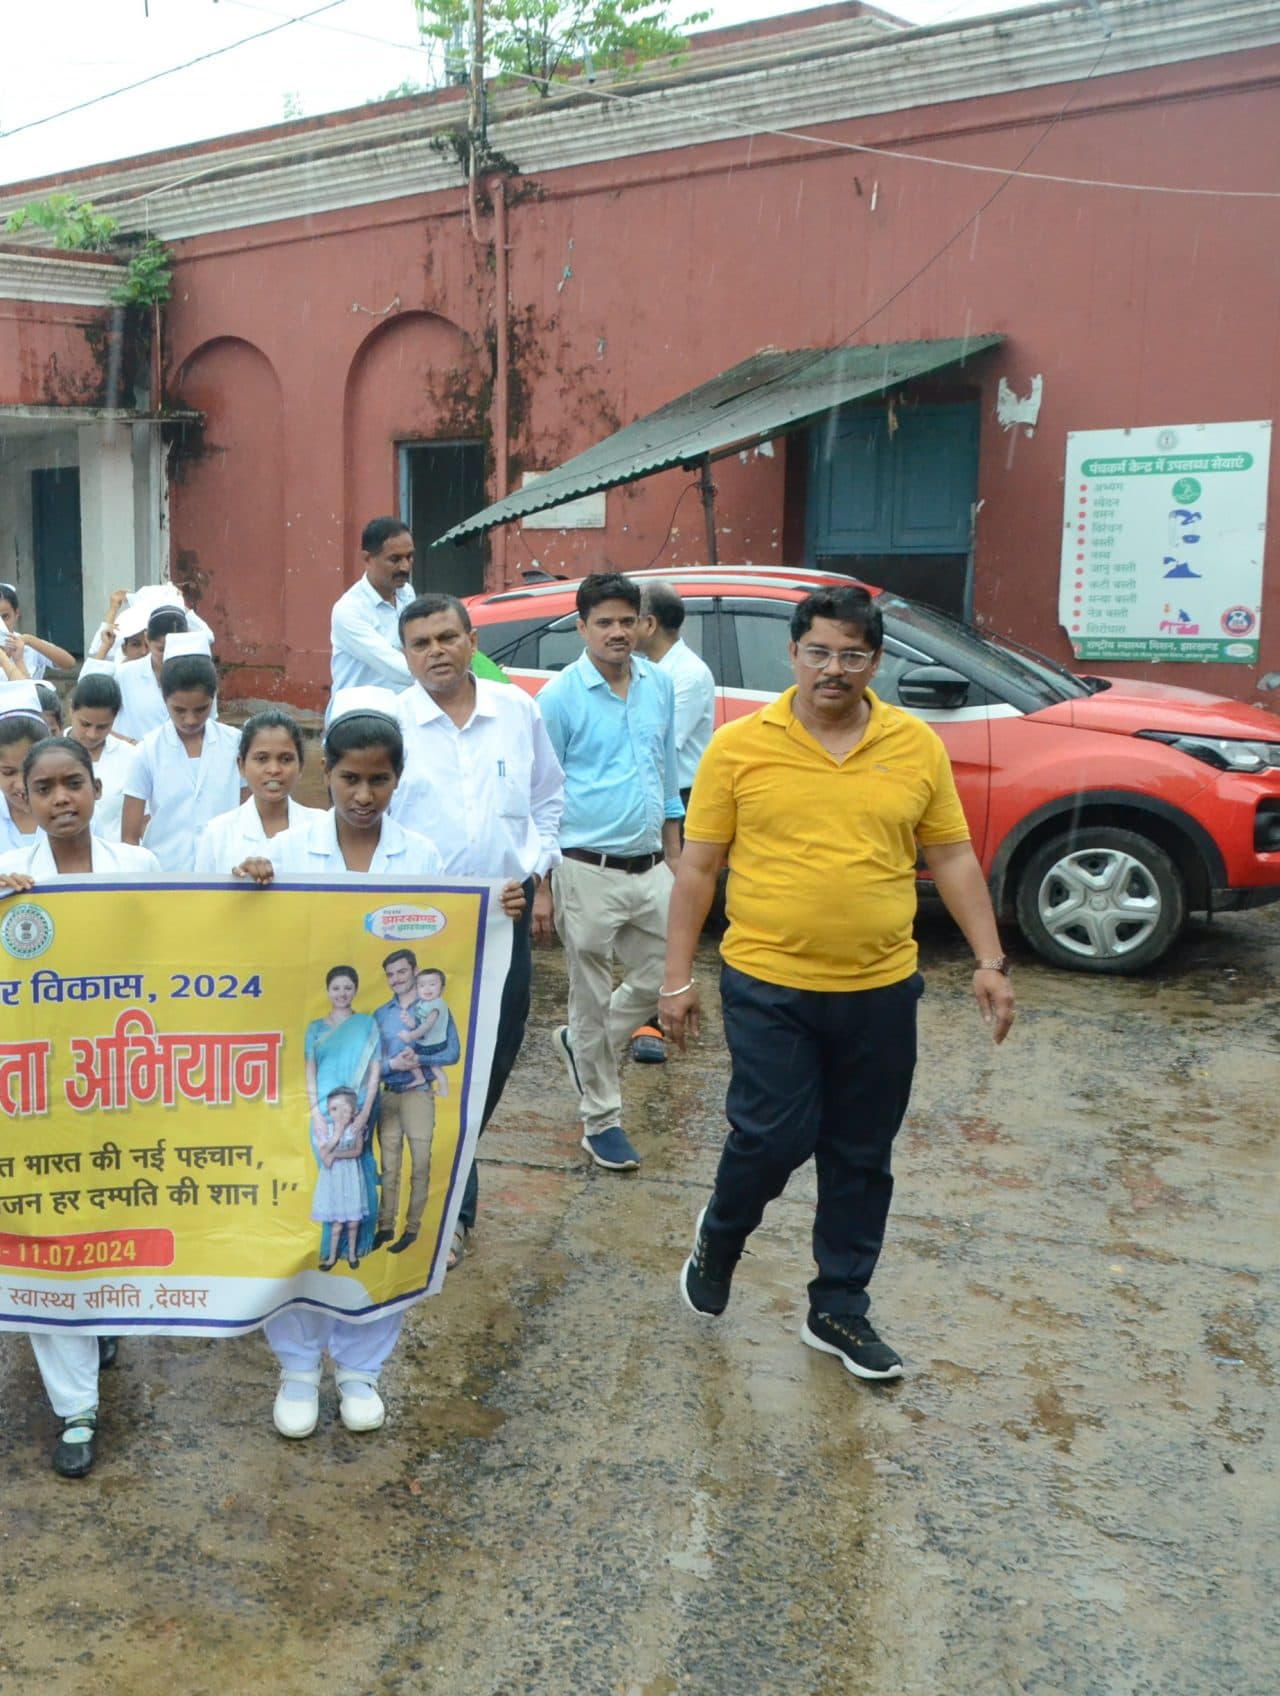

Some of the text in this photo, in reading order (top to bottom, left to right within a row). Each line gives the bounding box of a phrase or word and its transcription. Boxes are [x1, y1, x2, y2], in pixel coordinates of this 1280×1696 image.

[1088, 459, 1127, 474] पंचकर्म
[1155, 456, 1166, 472] में
[383, 914, 437, 925] झारखण्ड
[30, 970, 157, 1004] विकास,
[170, 974, 263, 999] 2024
[64, 1008, 283, 1108] अभियान
[24, 1152, 85, 1175] भारत
[89, 1142, 121, 1170] की
[129, 1138, 166, 1172] नई
[174, 1145, 263, 1170] पहचान,
[50, 1190, 82, 1214] हर
[87, 1178, 159, 1209] दम्पति
[167, 1176, 199, 1206] की
[207, 1184, 258, 1205] शान
[18, 1239, 136, 1266] 11.07.2024
[8, 1287, 76, 1310] स्वास्थ्य
[83, 1283, 141, 1309] समिति
